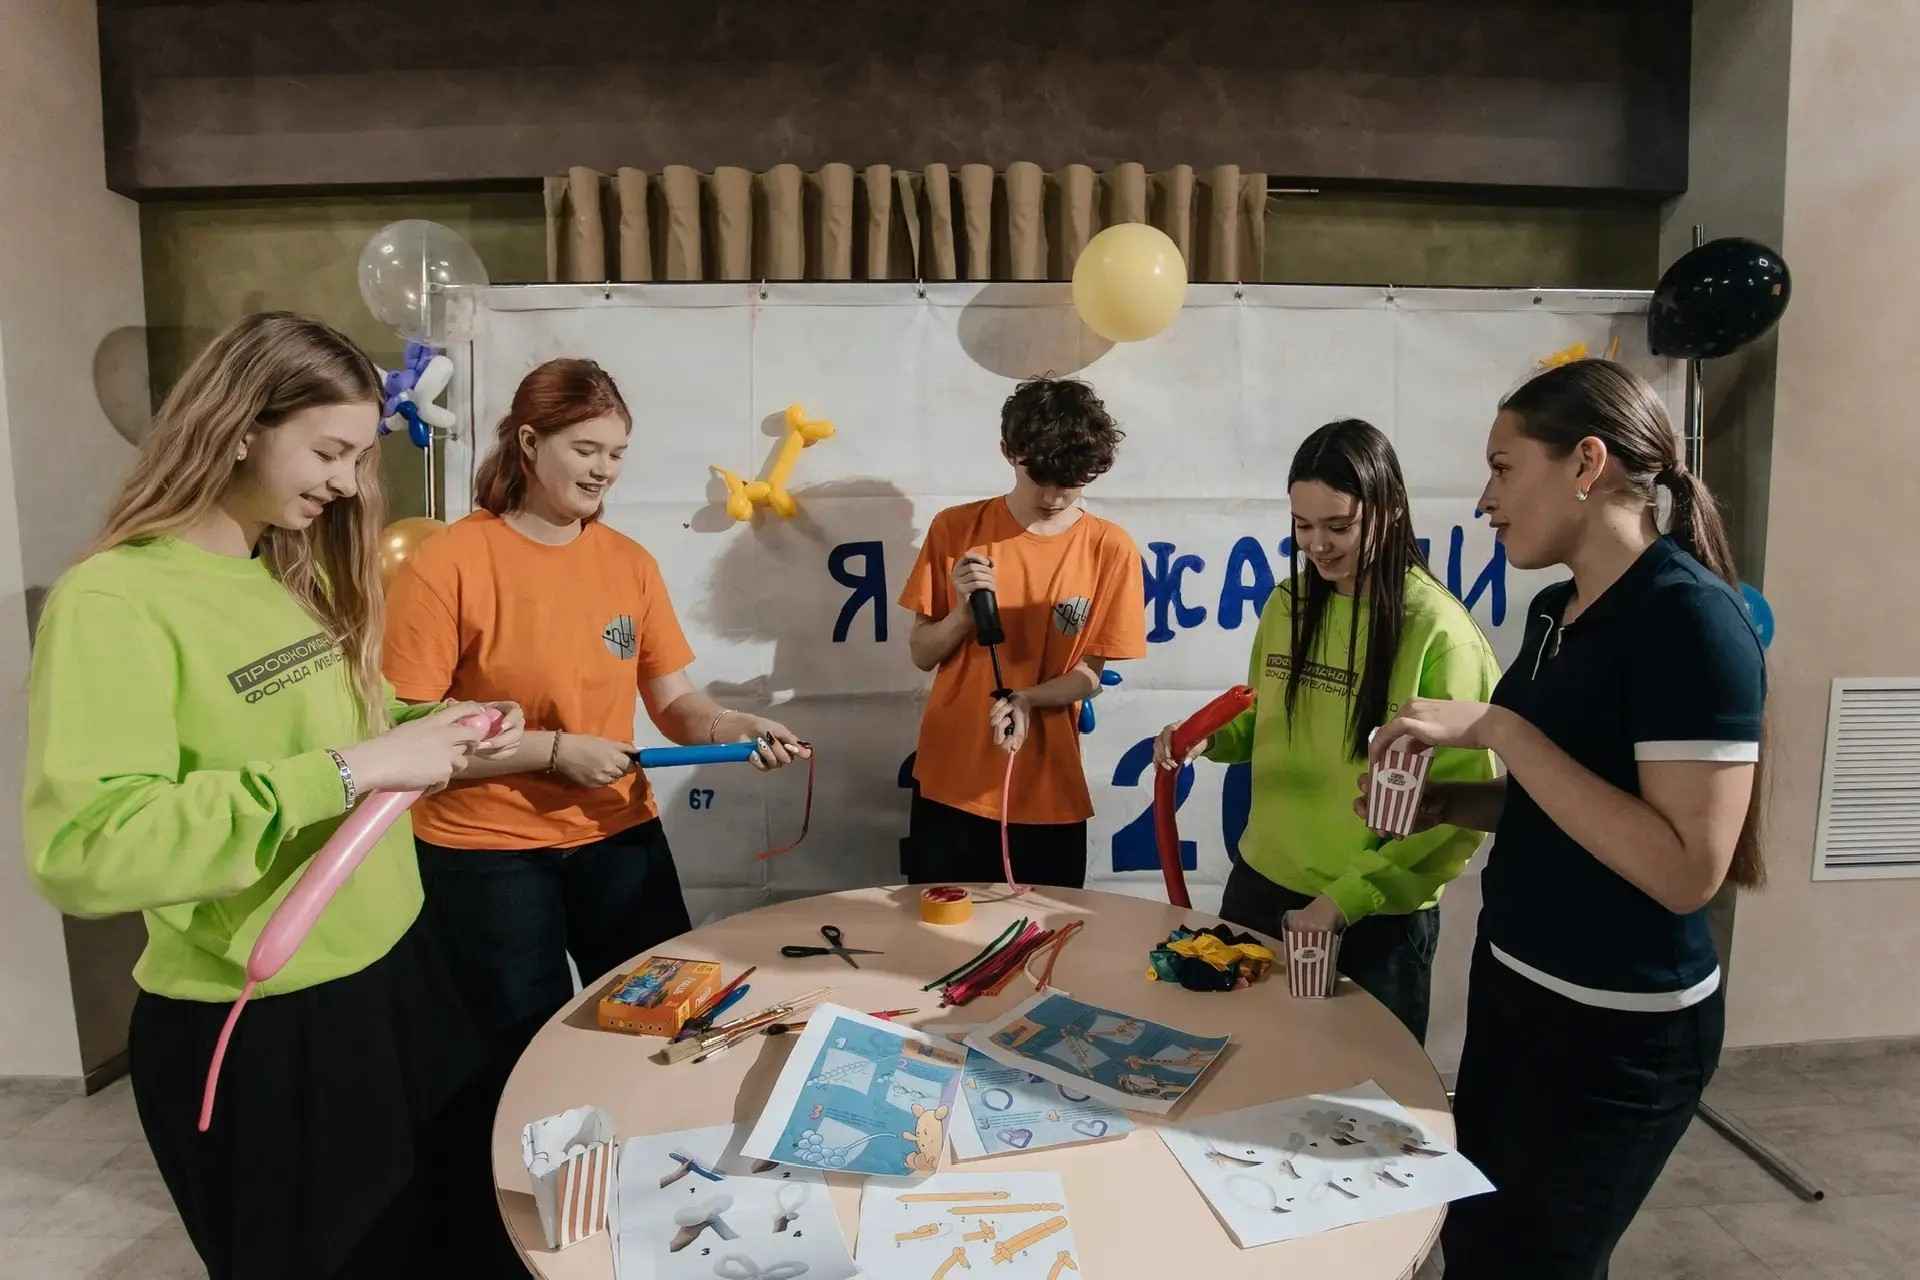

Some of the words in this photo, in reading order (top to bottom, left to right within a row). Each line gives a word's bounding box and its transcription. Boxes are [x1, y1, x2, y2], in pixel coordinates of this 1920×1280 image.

[827, 540, 888, 642] Я
[245, 665, 311, 704] ФОНДА
[689, 787, 715, 810] 67
[792, 1230, 803, 1238] 4
[700, 1247, 711, 1256] 3
